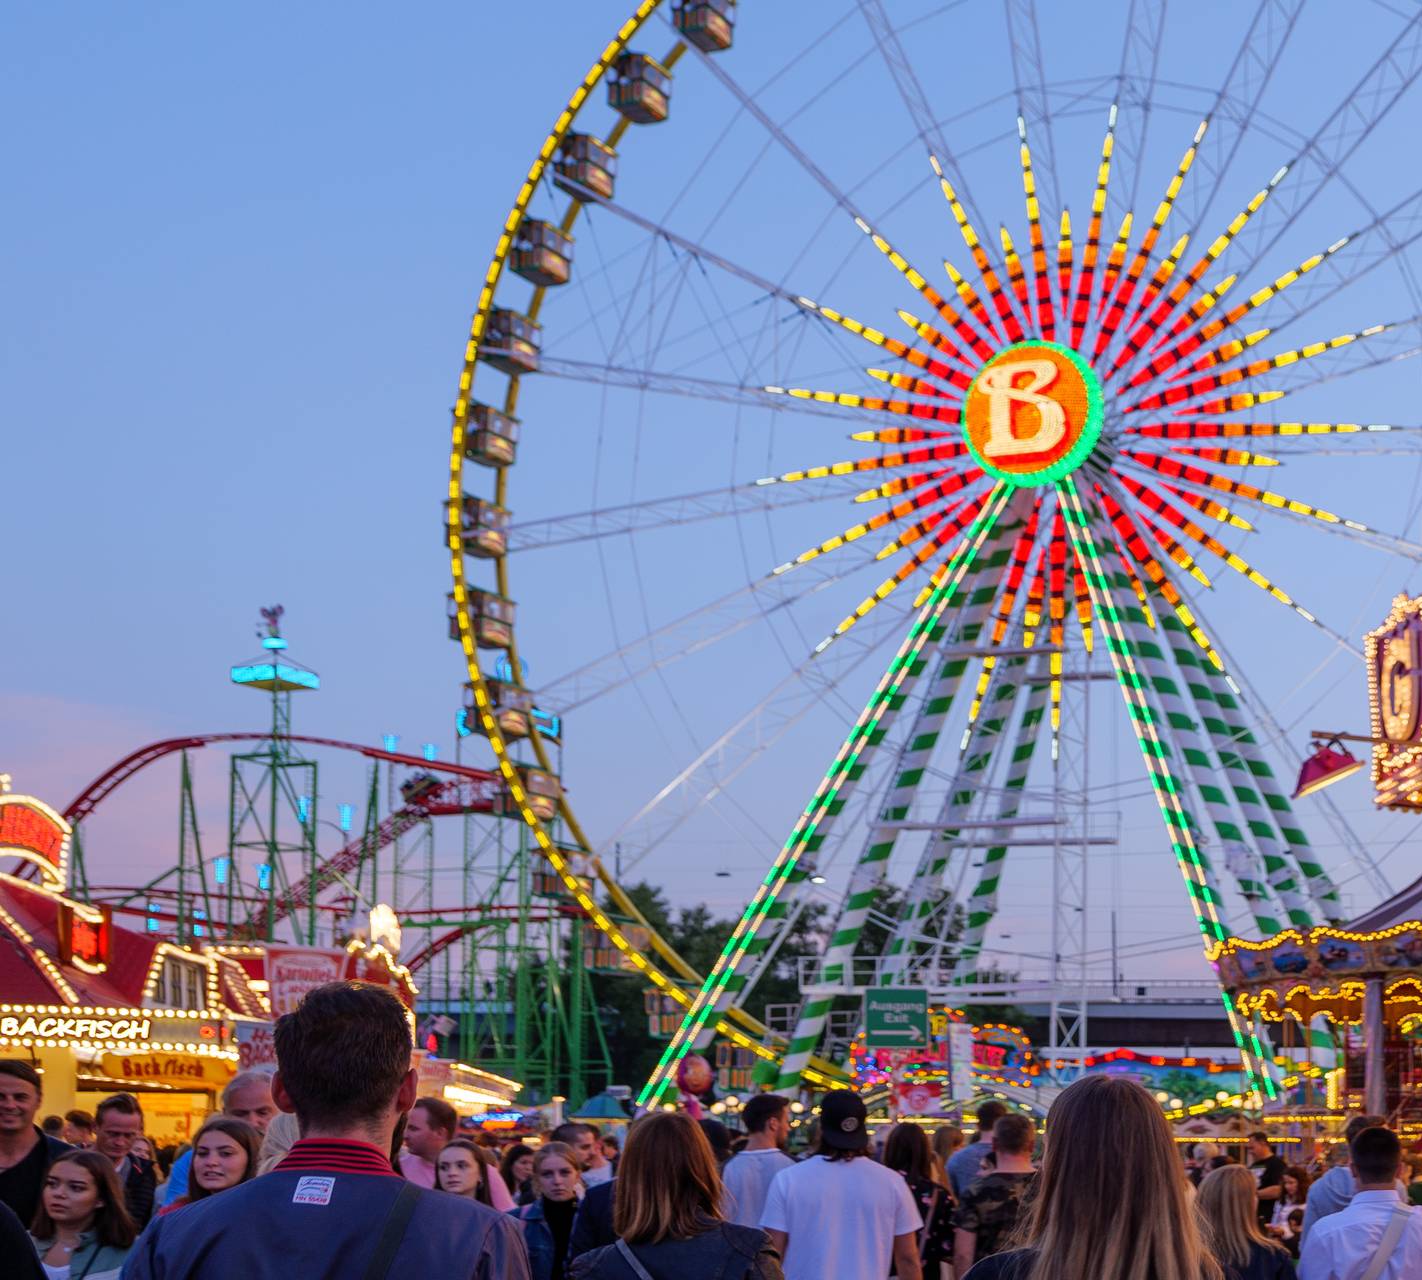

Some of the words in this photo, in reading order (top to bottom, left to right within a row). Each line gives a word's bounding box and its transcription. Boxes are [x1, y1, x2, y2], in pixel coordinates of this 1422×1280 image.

[977, 359, 1068, 458] B
[869, 1000, 924, 1013] Ausgang
[884, 1013, 909, 1023] Exit
[0, 1017, 150, 1040] BACKFISCH
